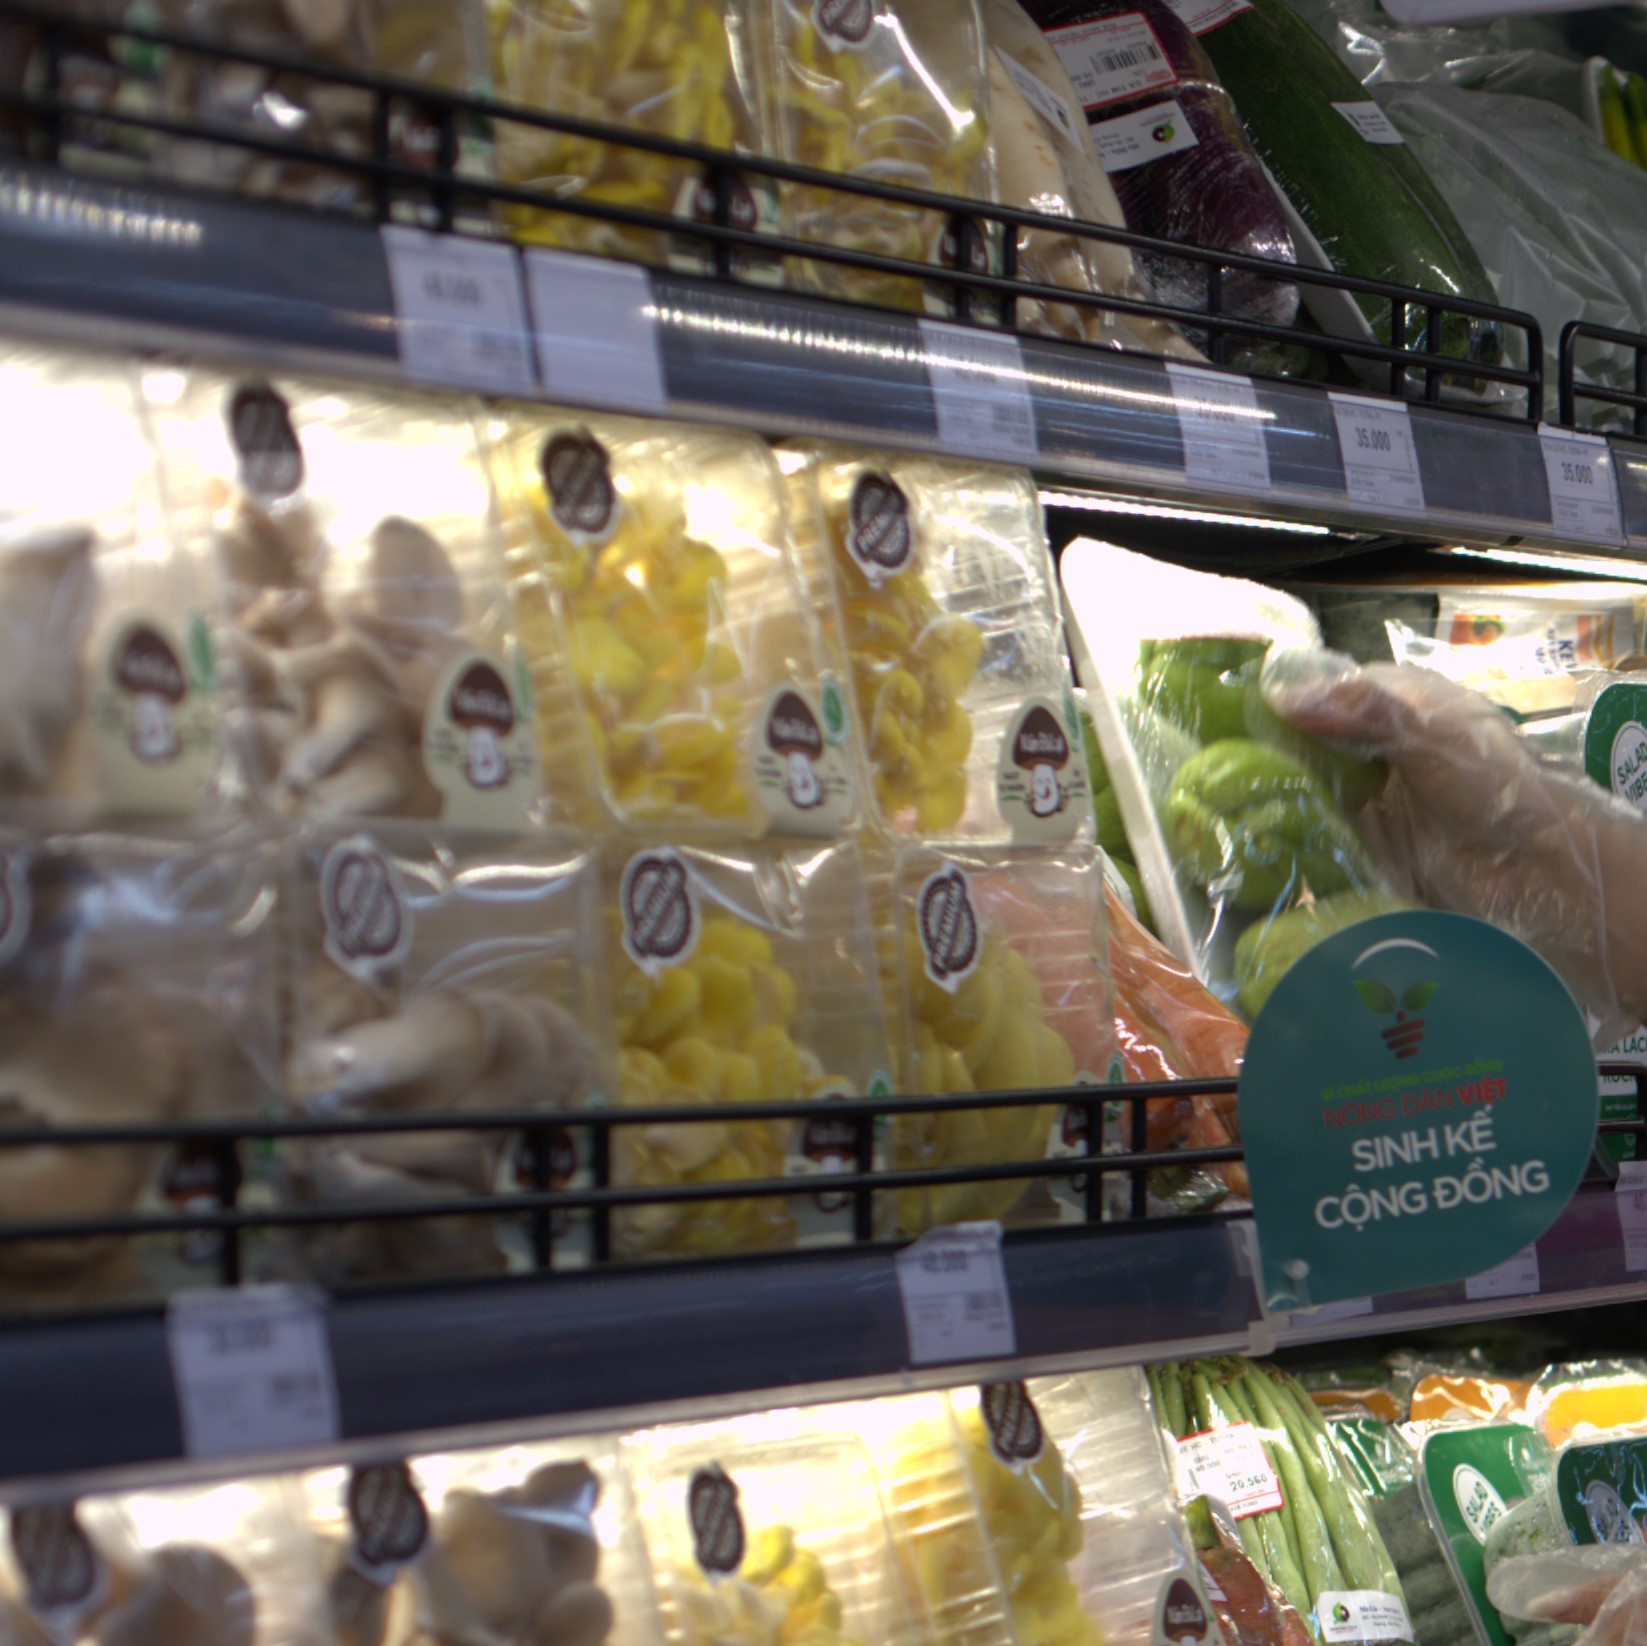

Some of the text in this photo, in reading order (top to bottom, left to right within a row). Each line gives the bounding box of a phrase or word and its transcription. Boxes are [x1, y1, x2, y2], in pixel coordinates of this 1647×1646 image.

[1355, 426, 1390, 453] 35.000
[1561, 462, 1594, 486] 35.000
[932, 882, 963, 972] PREMIUM
[1323, 1074, 1508, 1129] NÔNG DÂN VIỆT
[1352, 1103, 1497, 1172] SINH KẾ
[1315, 1156, 1550, 1232] CỘNG ĐỒNG
[1229, 1473, 1268, 1492] 20.560
